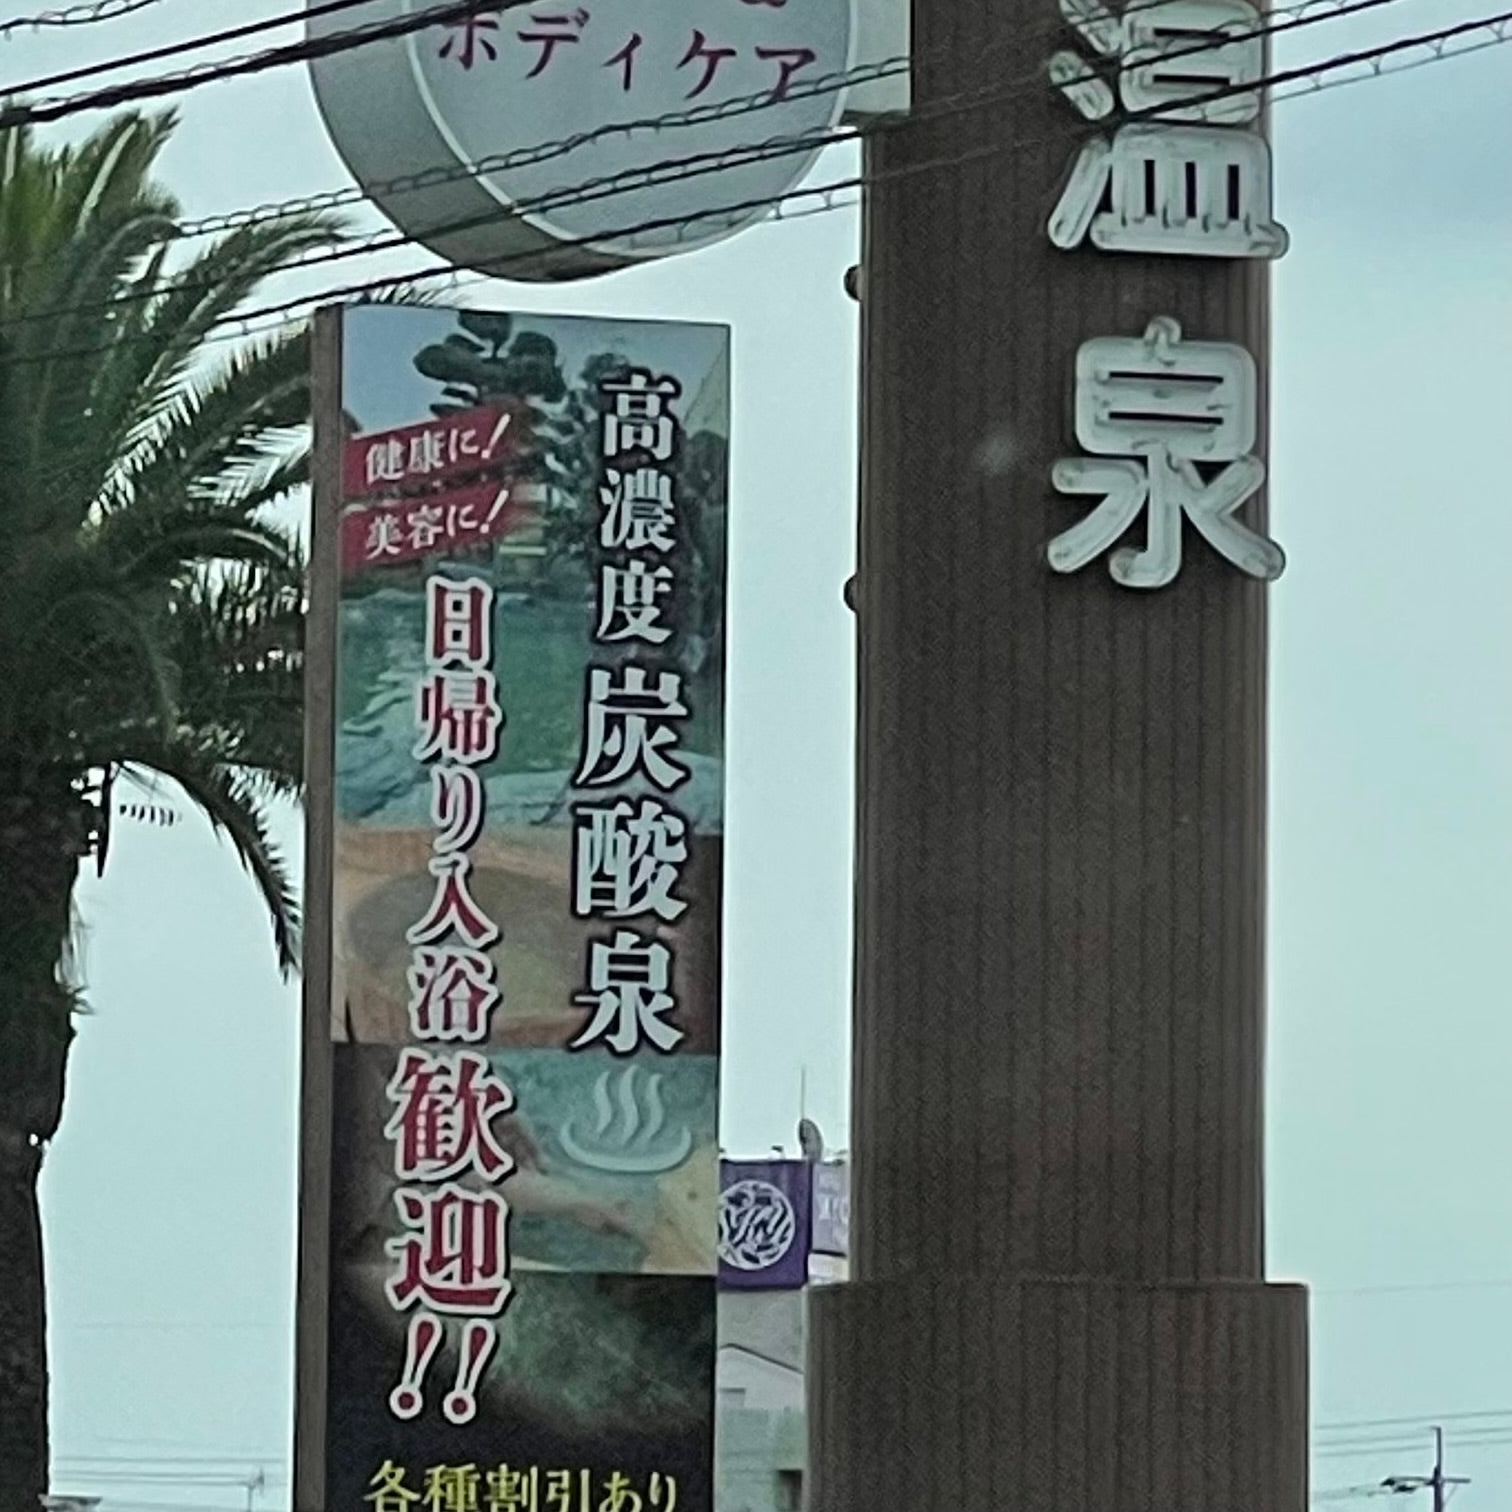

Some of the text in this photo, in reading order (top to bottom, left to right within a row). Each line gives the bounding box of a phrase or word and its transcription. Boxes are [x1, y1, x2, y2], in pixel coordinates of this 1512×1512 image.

[570, 372, 691, 1054] 高濃度炭酸泉
